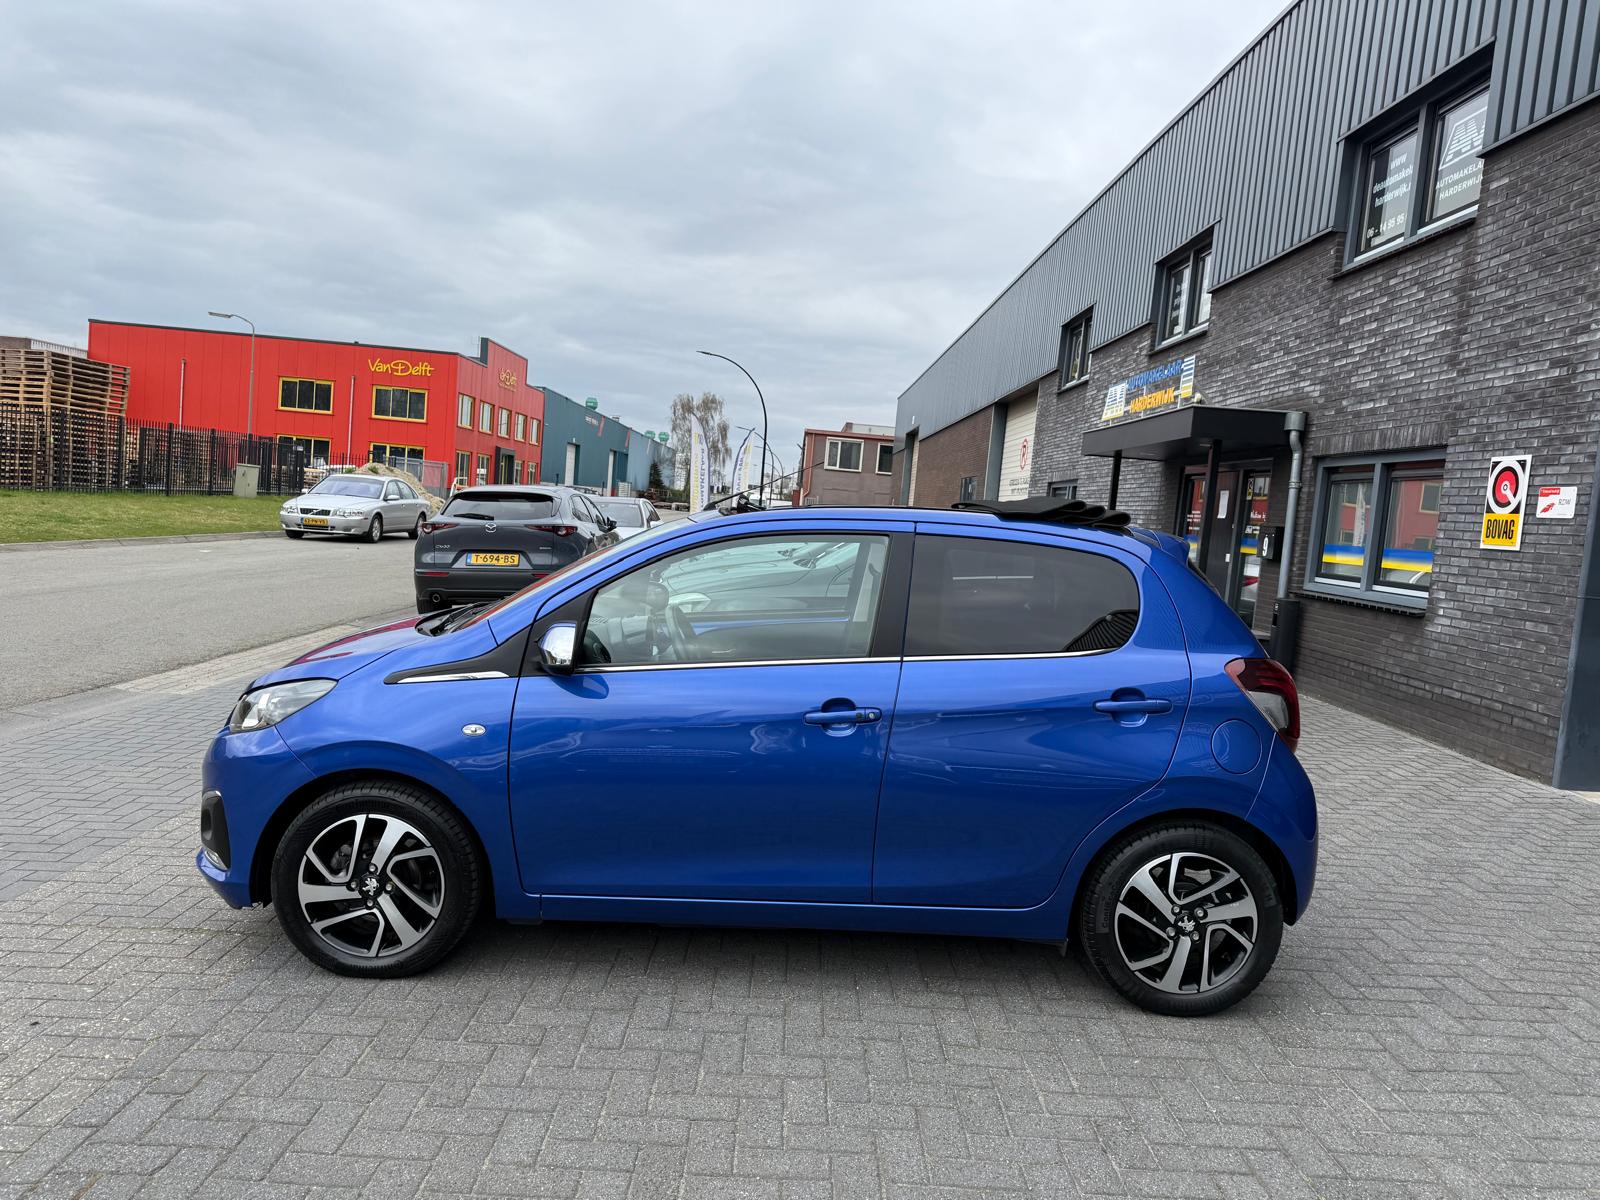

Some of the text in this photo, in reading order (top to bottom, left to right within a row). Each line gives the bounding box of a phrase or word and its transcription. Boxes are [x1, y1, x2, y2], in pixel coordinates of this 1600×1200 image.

[1129, 386, 1176, 413] HARDERWIJK
[1485, 518, 1515, 540] BOVAG
[1262, 536, 1269, 556] 9
[474, 554, 516, 564] T-694-BS
